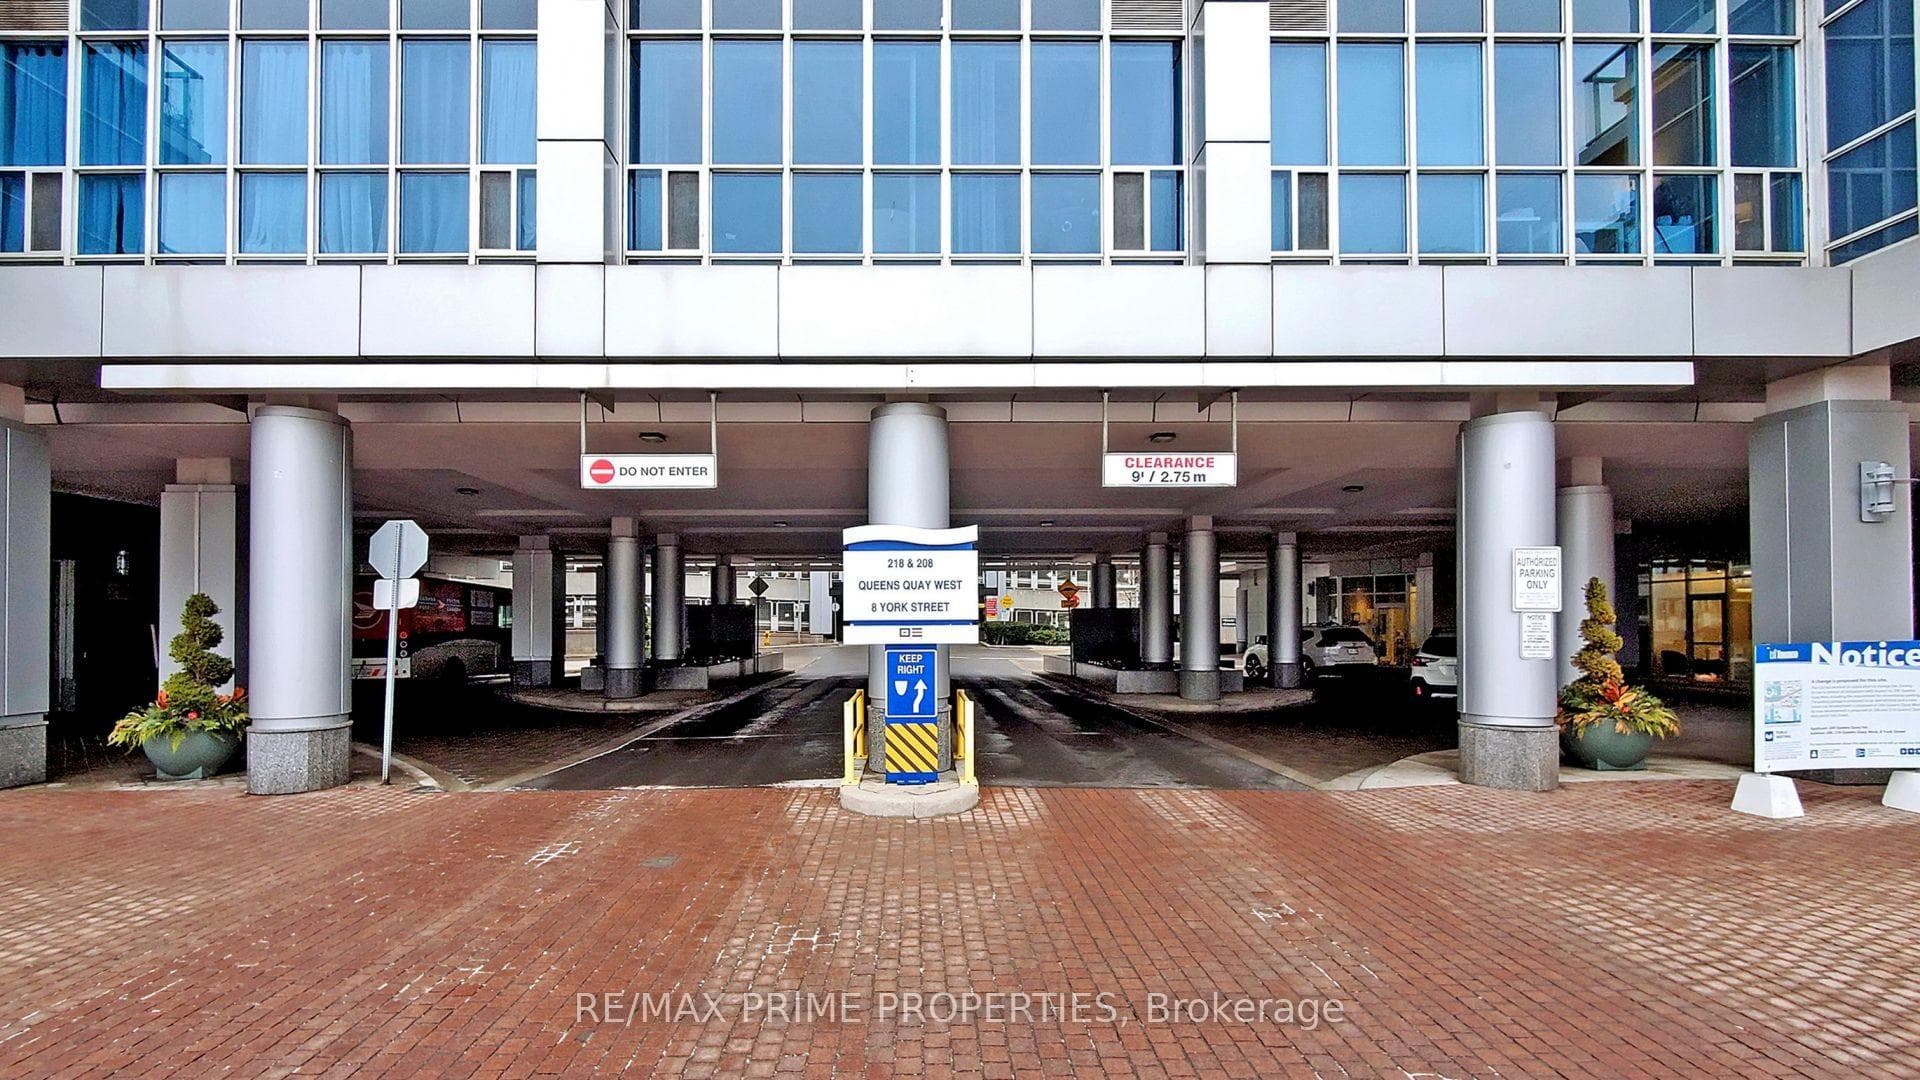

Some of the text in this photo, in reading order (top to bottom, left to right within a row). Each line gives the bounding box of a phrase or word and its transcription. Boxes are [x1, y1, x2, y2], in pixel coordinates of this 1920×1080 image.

[1124, 457, 1215, 468] CLEARANCE
[619, 466, 708, 476] DO NOT ENTER
[887, 558, 934, 568] 218 & 208
[1517, 557, 1557, 567] AUTHORIZED
[1519, 568, 1556, 578] PARKING
[858, 580, 963, 590] QUEENS QUAY WEST
[1526, 580, 1548, 589] ONLY
[871, 602, 950, 612] 8 YORK STREET
[899, 654, 923, 663] KEEP
[1811, 641, 1920, 667] Notice
[897, 665, 925, 675] RIGHT
